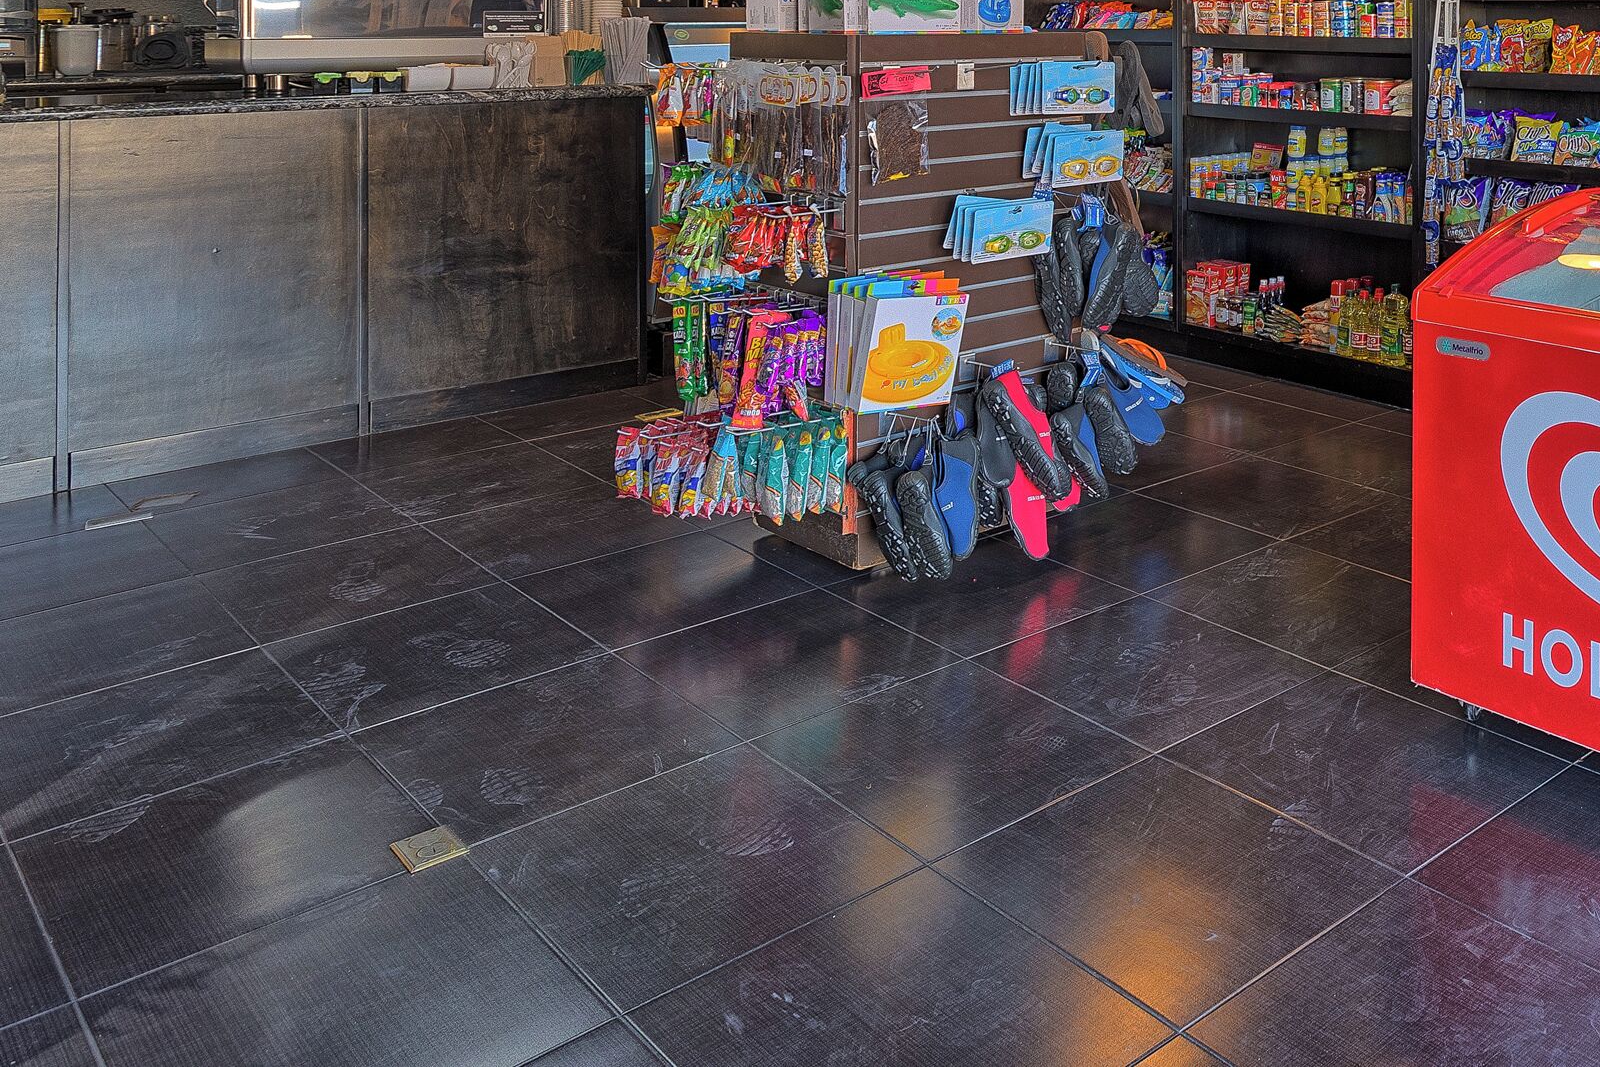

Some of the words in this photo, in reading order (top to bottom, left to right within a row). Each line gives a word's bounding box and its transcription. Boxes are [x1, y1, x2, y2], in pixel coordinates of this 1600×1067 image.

[1558, 134, 1591, 152] Chips
[937, 297, 966, 305] INTEX
[1452, 343, 1485, 357] Metalfrio
